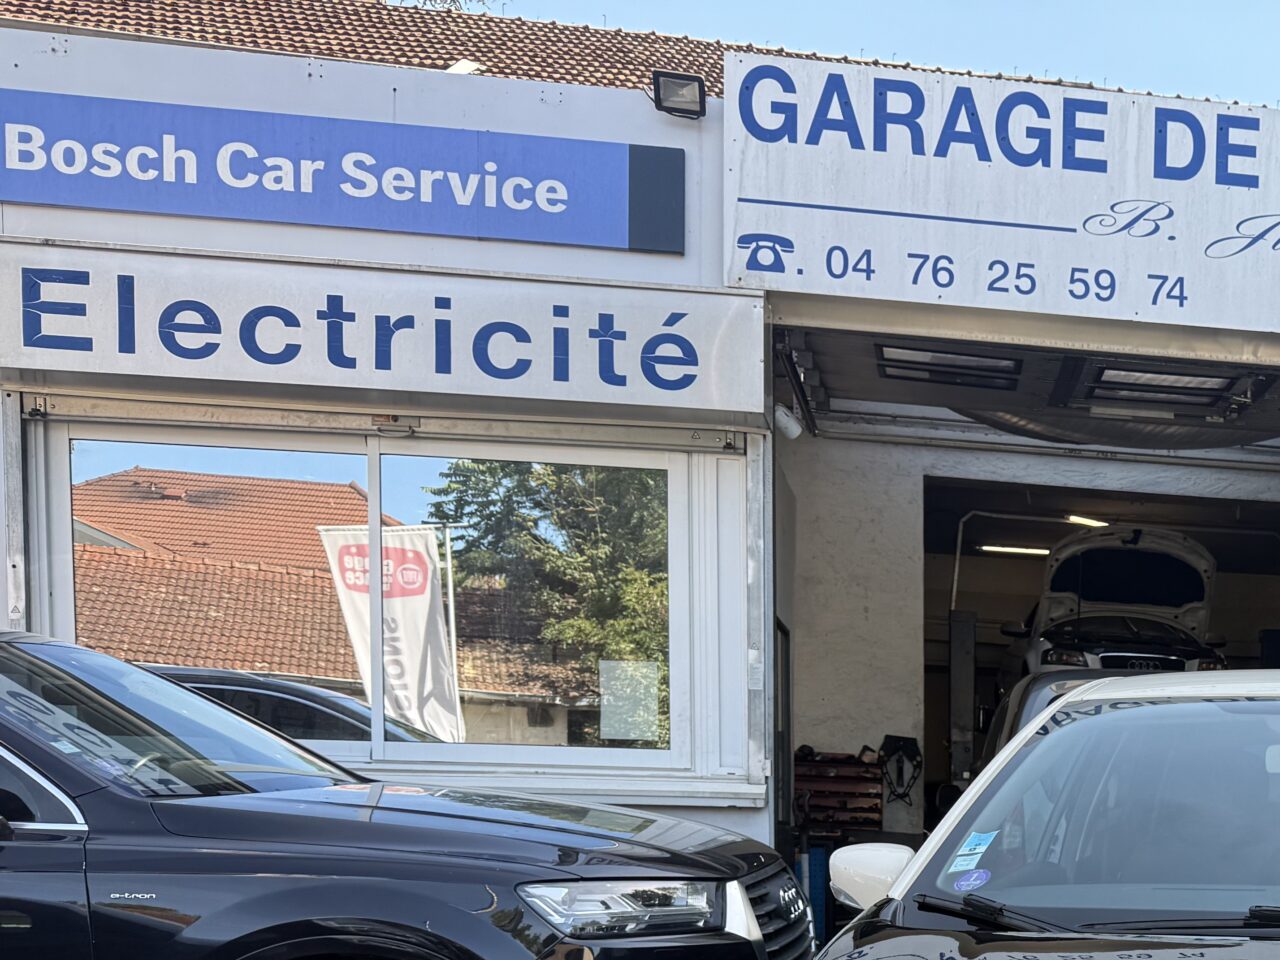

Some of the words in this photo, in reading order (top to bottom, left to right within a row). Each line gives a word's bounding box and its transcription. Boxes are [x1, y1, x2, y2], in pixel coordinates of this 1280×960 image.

[5, 123, 198, 184] Bosch
[216, 142, 325, 194] Car
[339, 151, 569, 214] Service
[738, 64, 1109, 174] GARAGE
[1153, 107, 1261, 189] DE
[1082, 199, 1177, 241] B.
[825, 245, 876, 281] 04
[906, 253, 955, 289] 76
[986, 260, 1037, 295] 25
[1067, 267, 1117, 302] 59
[1147, 273, 1188, 308] 74
[21, 266, 699, 391] Electricité
